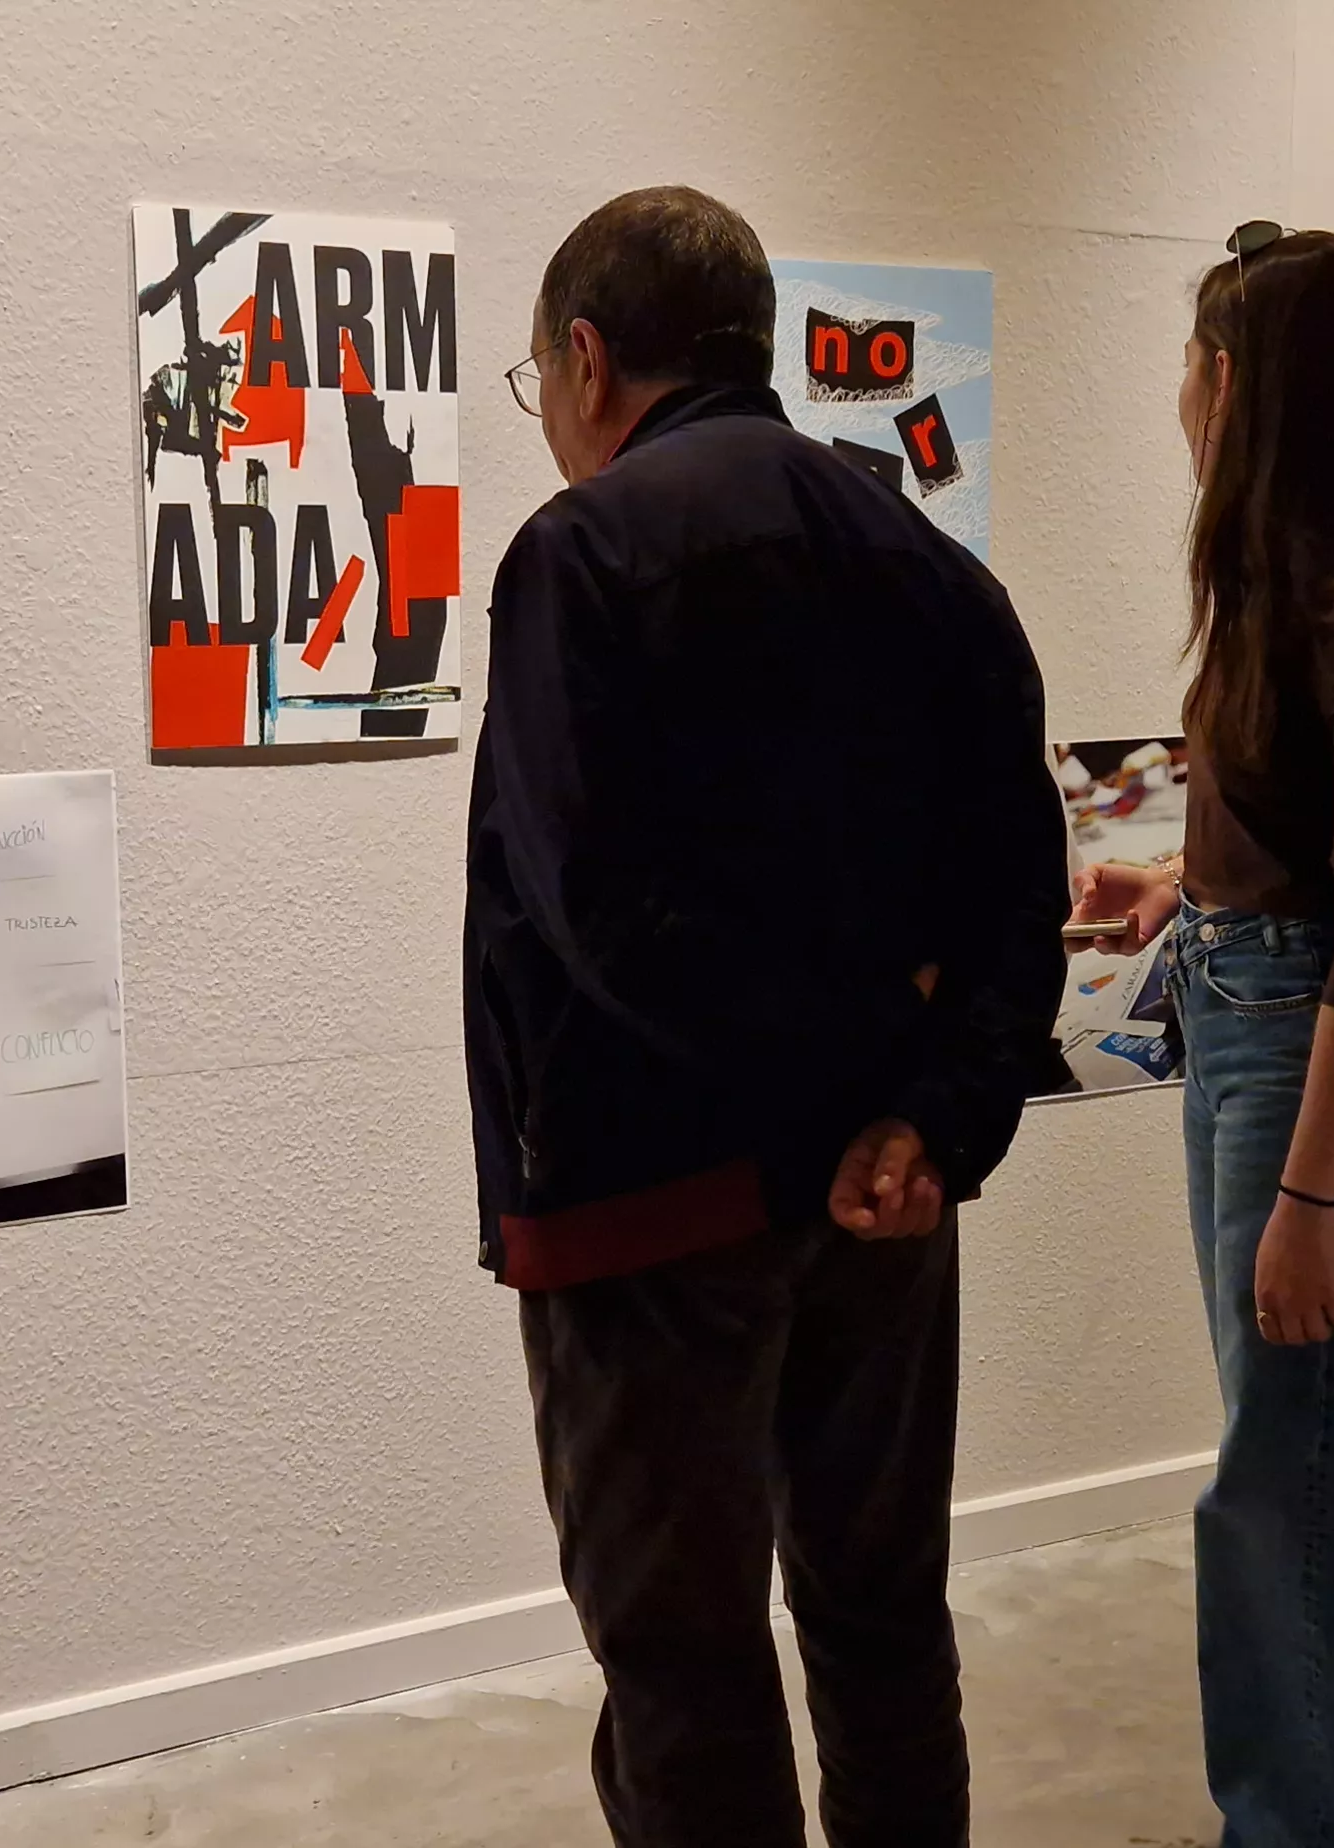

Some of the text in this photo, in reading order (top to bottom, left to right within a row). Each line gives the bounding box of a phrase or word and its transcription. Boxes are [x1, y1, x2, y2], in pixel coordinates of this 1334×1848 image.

[247, 241, 456, 394] ARM
[911, 413, 939, 468] r
[150, 503, 346, 645] ADA
[5, 916, 78, 932] TRISTEZA
